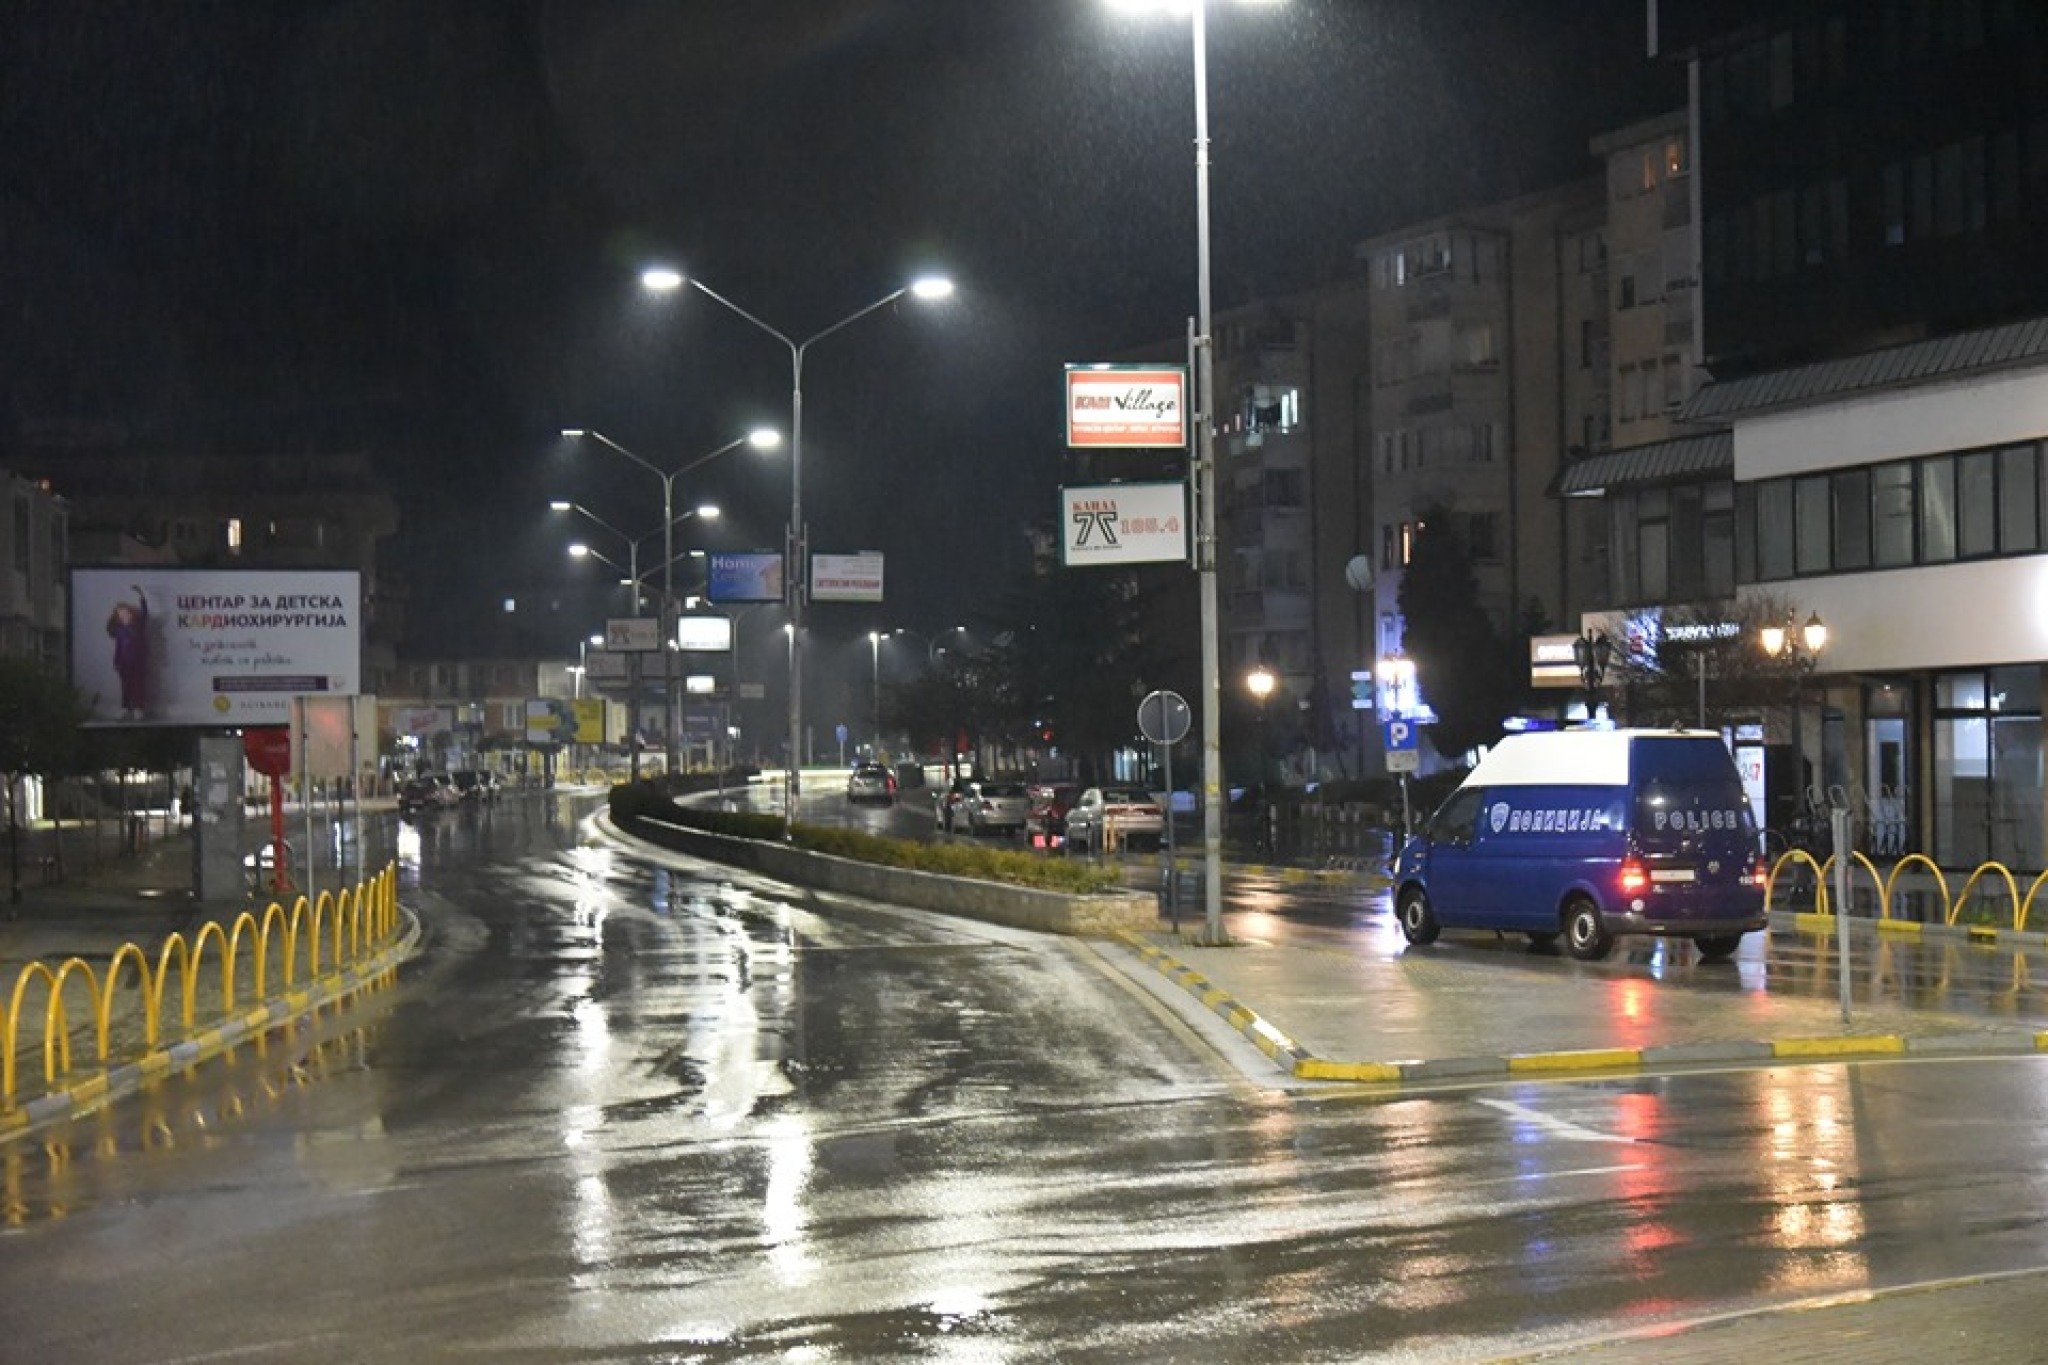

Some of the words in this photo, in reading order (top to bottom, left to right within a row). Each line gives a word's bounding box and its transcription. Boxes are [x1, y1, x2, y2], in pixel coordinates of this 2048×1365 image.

[1114, 388, 1176, 418] Village
[177, 595, 245, 610] ЦЕНТАР
[250, 595, 271, 609] ЗА
[275, 594, 343, 610] ДЕТСКА
[177, 613, 347, 628] КАРДИОХИРУРГИЈА
[1654, 810, 1738, 831] POLICE
